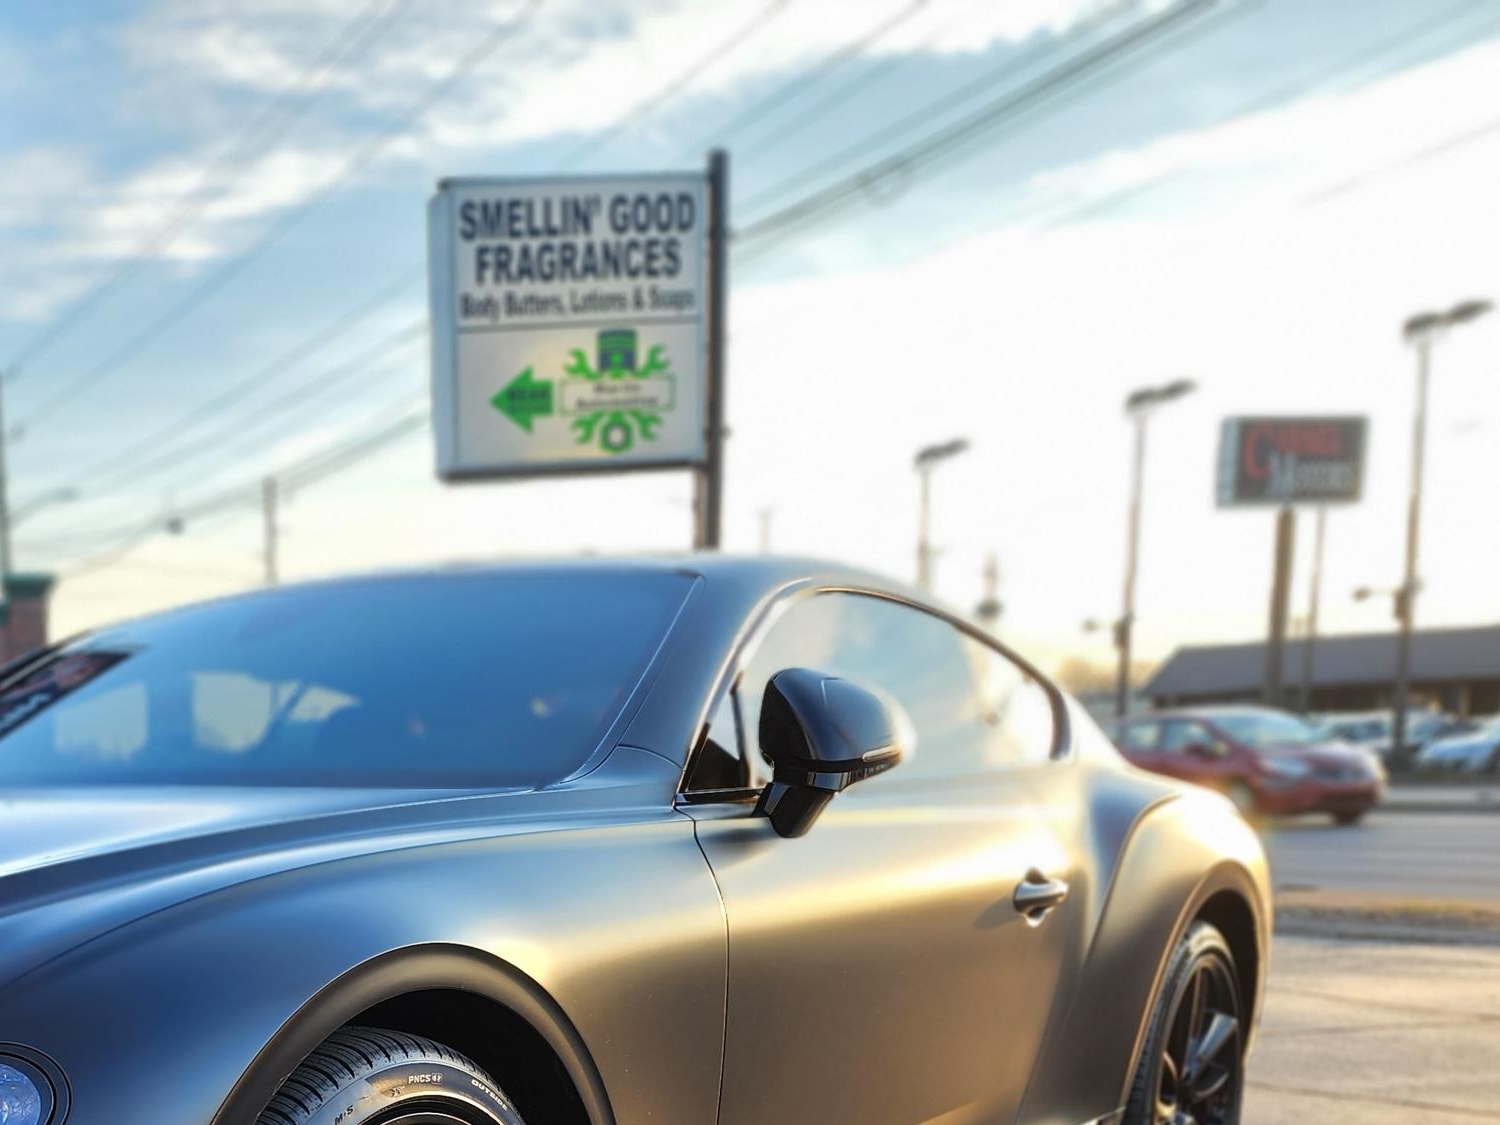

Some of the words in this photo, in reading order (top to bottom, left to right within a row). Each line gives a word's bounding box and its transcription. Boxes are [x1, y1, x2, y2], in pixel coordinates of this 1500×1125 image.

[460, 197, 600, 241] SMELLIN'
[609, 193, 696, 234] GOOD
[475, 238, 682, 284] FRAGRANCES
[461, 293, 500, 321] Body
[569, 289, 628, 315] Lotions
[632, 288, 644, 311] &
[650, 284, 696, 315] Soaps
[408, 1073, 431, 1085] PNCS
[471, 1079, 508, 1111] OUTSIDE
